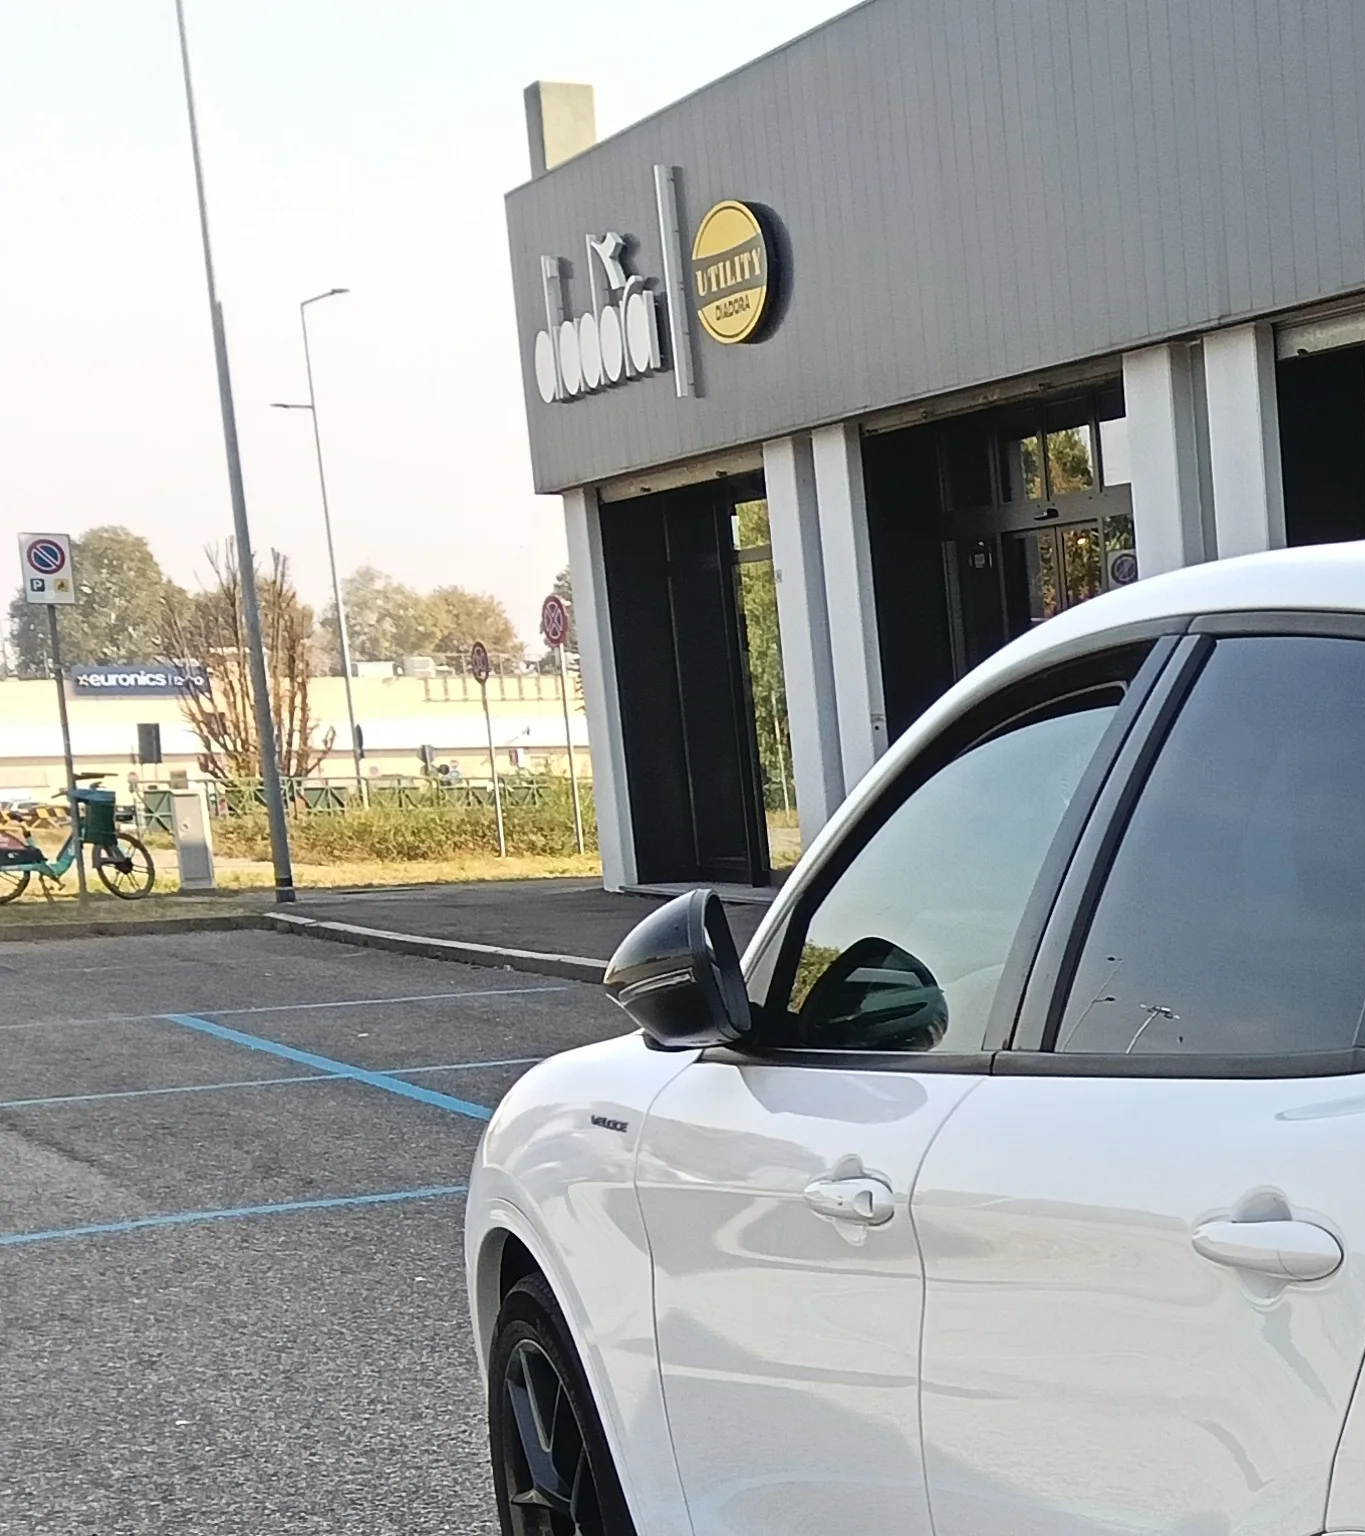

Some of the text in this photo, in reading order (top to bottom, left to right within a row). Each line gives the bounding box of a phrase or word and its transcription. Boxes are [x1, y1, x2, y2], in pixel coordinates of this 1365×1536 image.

[695, 247, 761, 297] UTILITY
[715, 294, 751, 321] DIADORA
[89, 670, 167, 687] euronics
